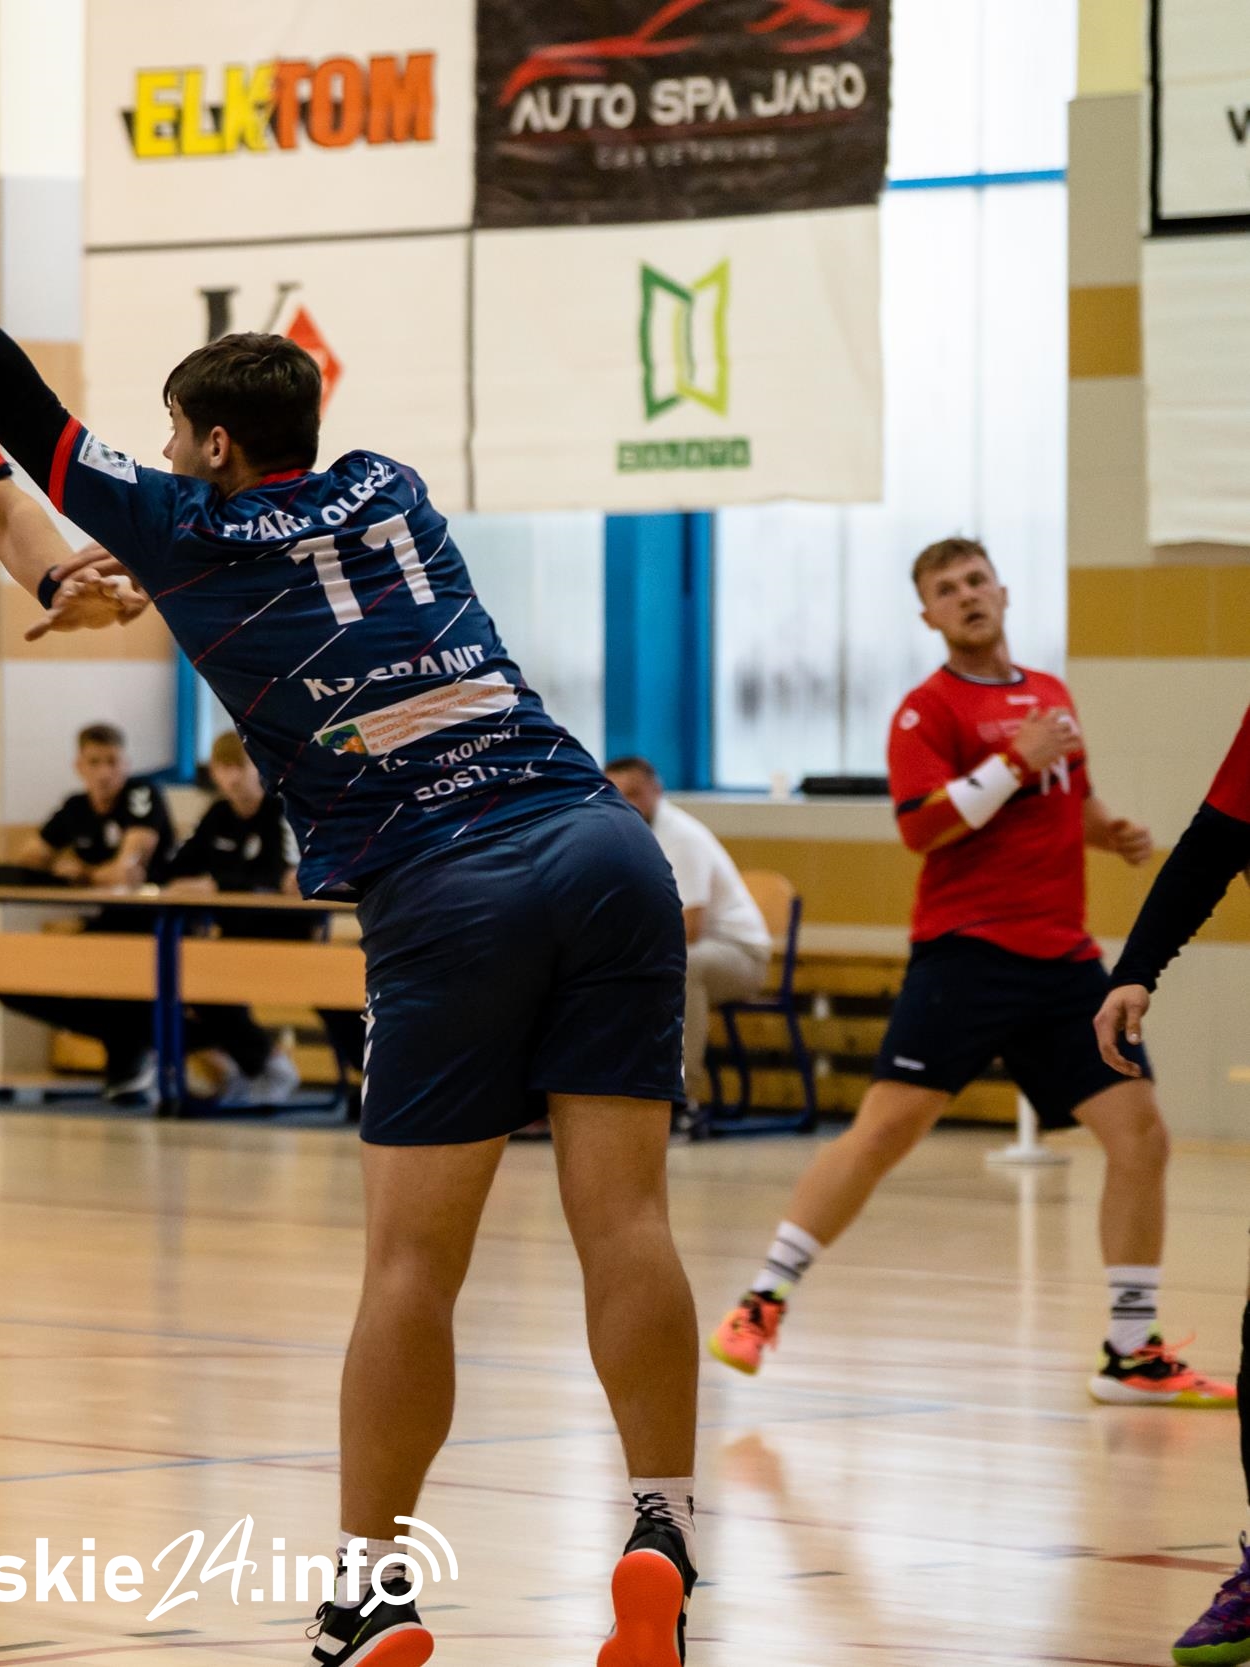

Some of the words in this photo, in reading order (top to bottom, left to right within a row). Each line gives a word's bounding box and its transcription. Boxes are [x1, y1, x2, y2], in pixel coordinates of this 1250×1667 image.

[133, 51, 436, 157] ELKTOM
[508, 82, 636, 135] AUTO
[650, 75, 738, 127] SPA
[751, 60, 867, 119] JARO
[286, 513, 436, 626] 11
